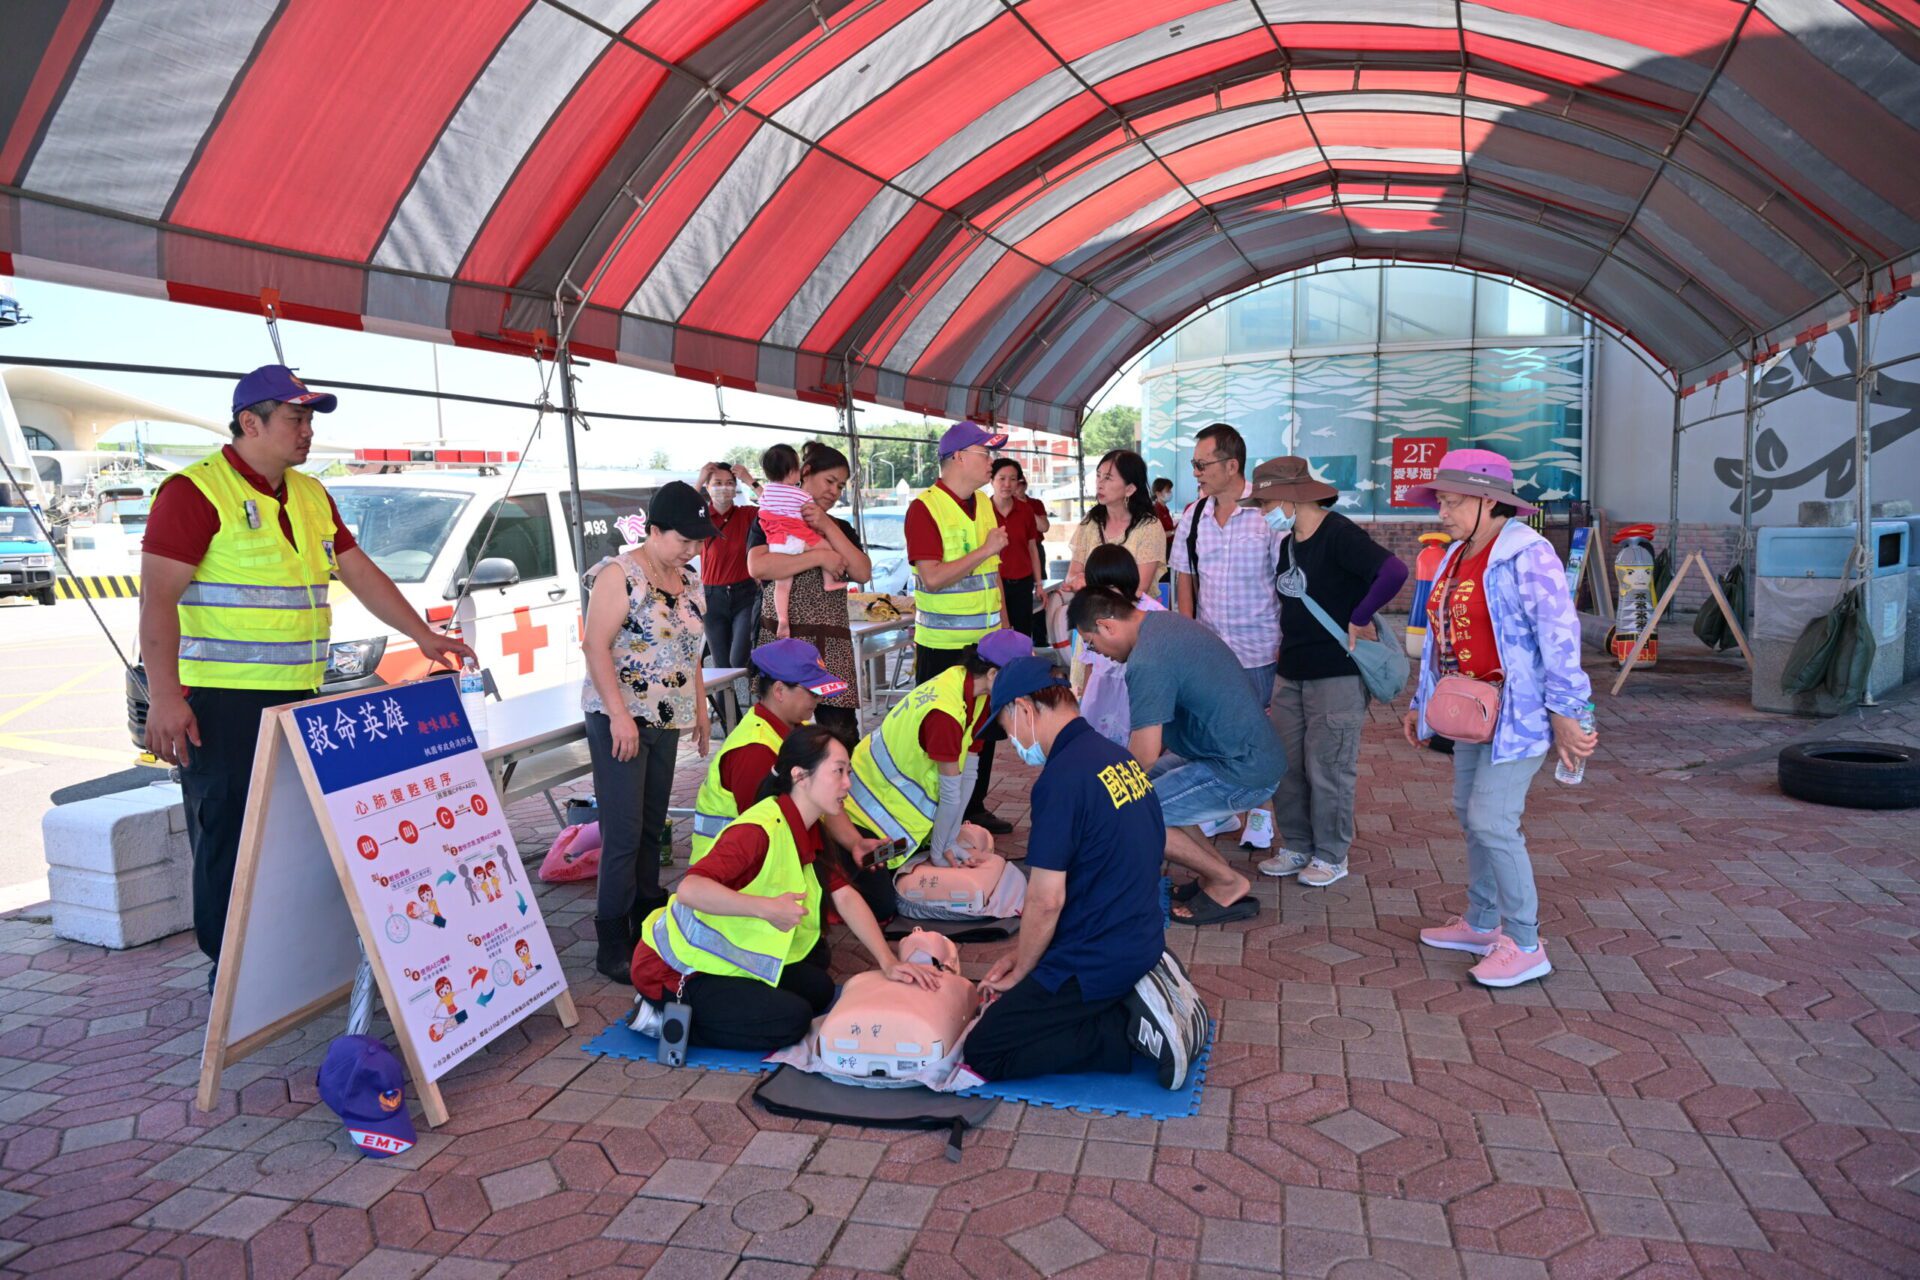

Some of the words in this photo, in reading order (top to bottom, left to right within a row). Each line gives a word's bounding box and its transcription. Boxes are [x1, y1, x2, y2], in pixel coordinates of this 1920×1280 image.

[1403, 443, 1436, 463] 2F
[820, 683, 844, 693] EMT
[306, 696, 410, 757] 救命英雄
[424, 735, 474, 757] 桃園市政府消防局
[355, 772, 452, 815] 心肺復甦程序
[361, 839, 376, 855] 叫
[402, 823, 416, 840] 叫
[440, 811, 451, 825] C
[474, 799, 485, 812] D
[1138, 1016, 1163, 1059] N
[362, 1134, 404, 1151] EMT
